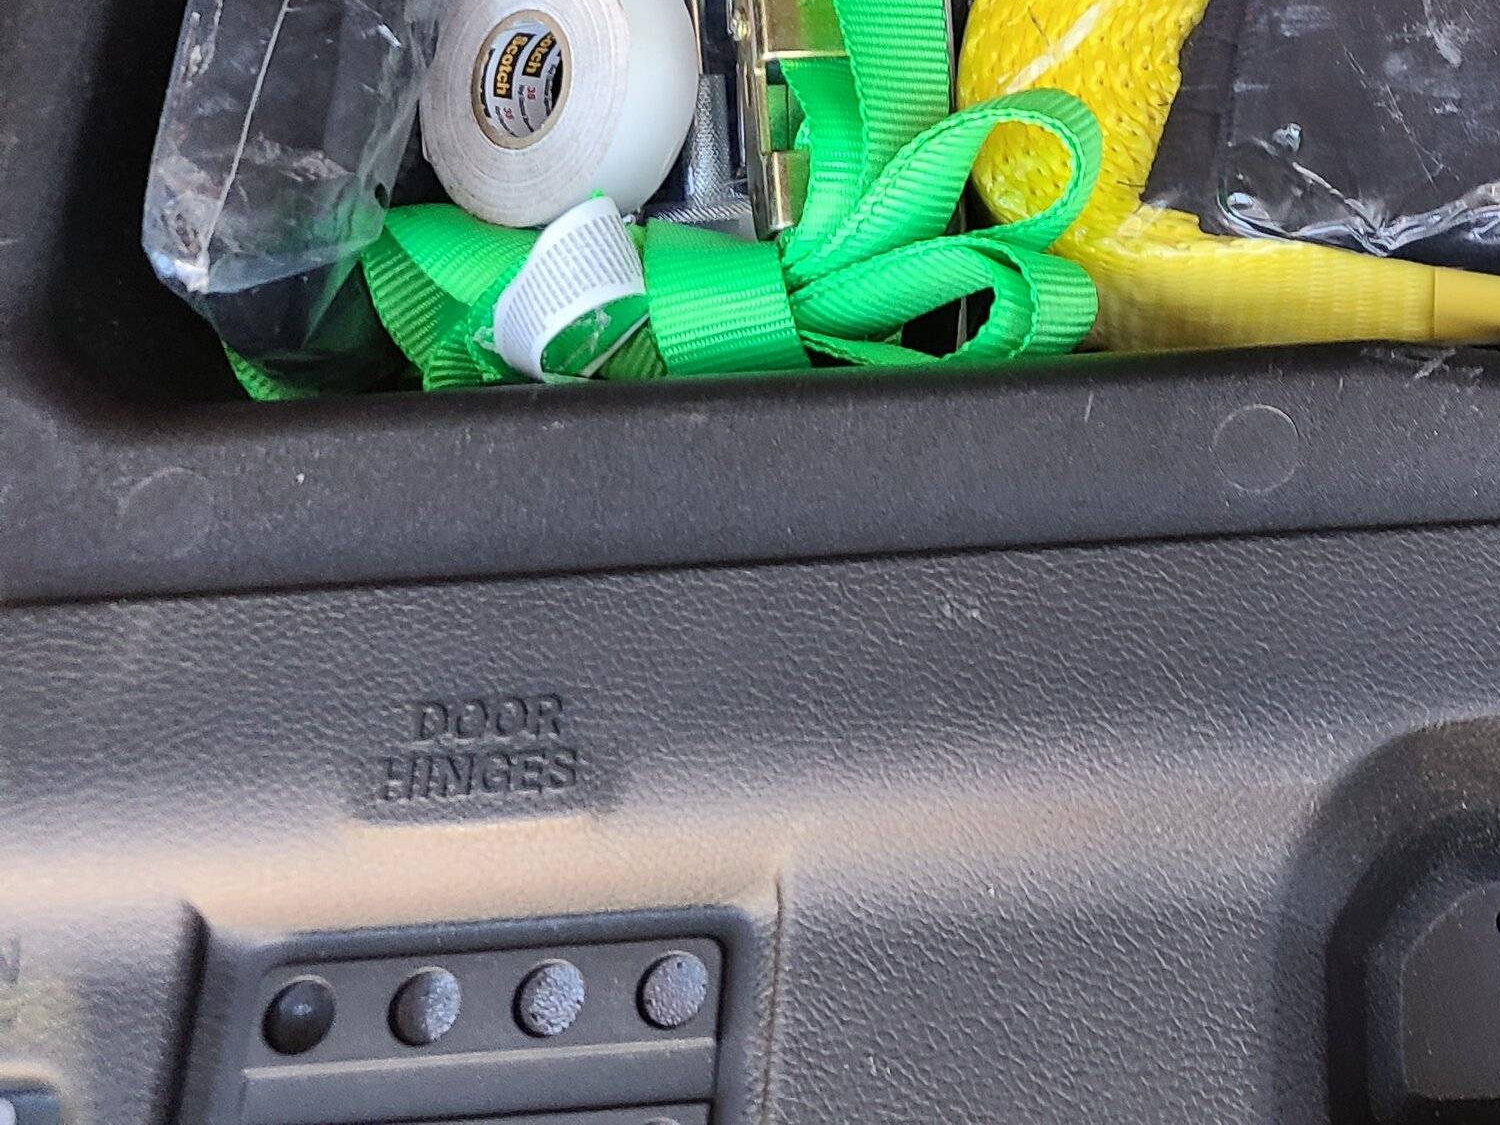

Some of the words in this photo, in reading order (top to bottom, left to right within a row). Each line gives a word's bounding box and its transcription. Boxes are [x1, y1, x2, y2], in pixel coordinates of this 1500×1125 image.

[496, 35, 529, 96] Scotch
[526, 35, 554, 75] otch
[418, 692, 564, 741] DOOR
[384, 746, 578, 801] HINGES
